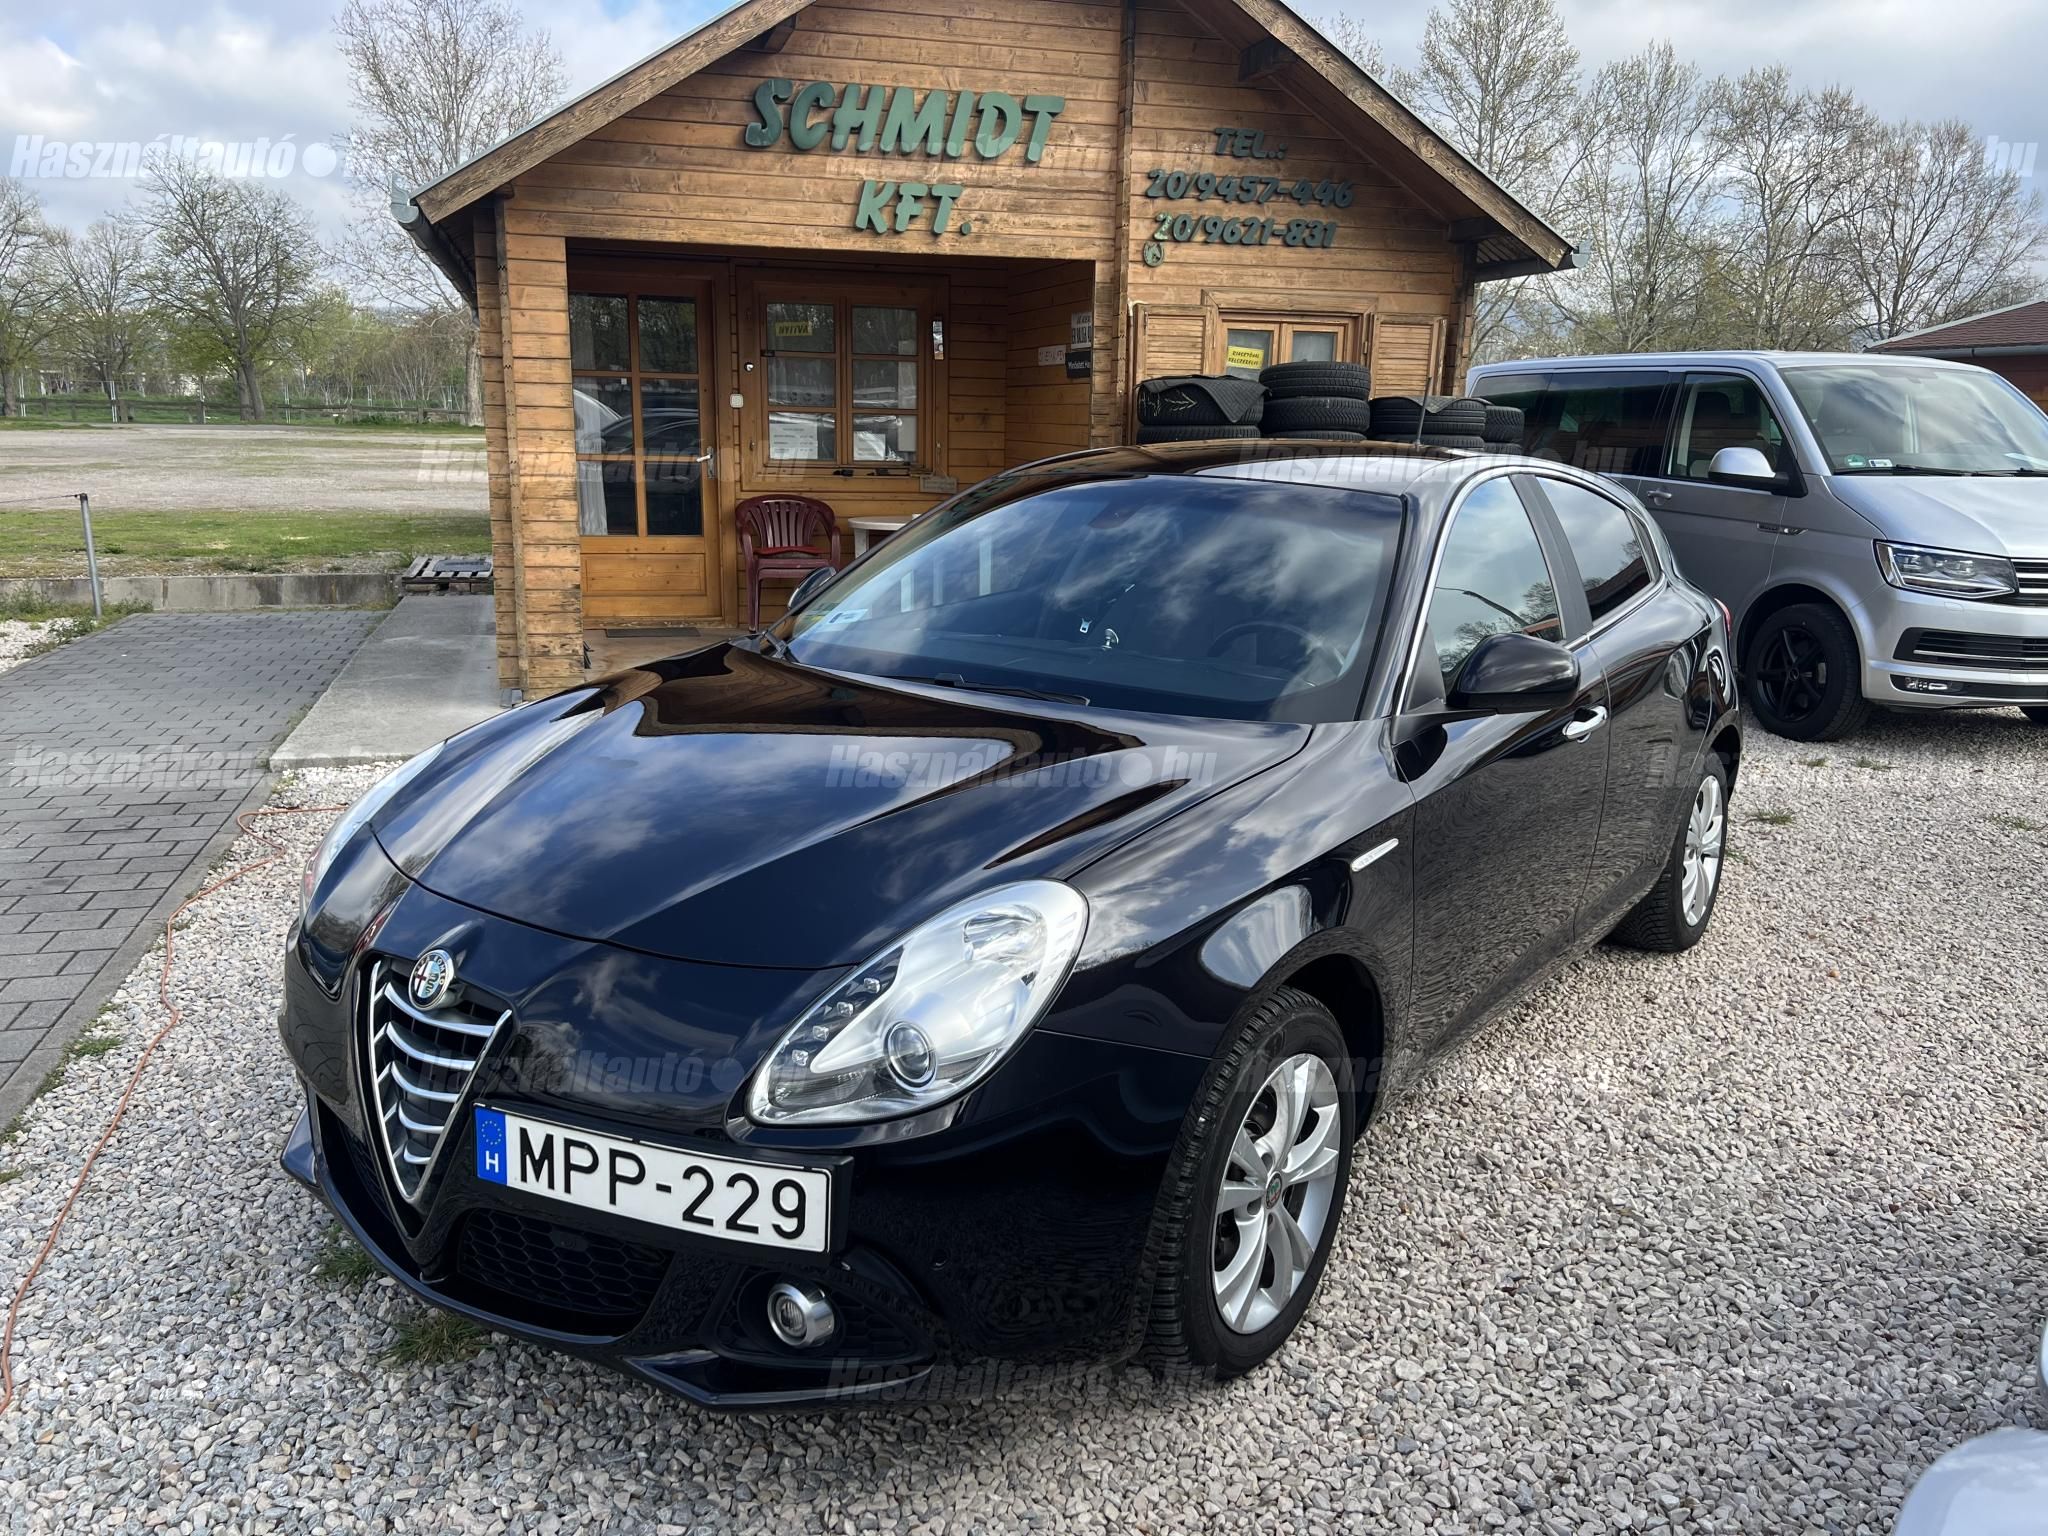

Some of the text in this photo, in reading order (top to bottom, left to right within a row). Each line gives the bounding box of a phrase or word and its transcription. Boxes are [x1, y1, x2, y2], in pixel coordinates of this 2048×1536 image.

[745, 79, 1065, 162] SCHMIDT
[1215, 127, 1287, 159] TEL.:
[855, 179, 972, 234] KFT.
[1146, 168, 1354, 208] 20/9457-446
[1153, 211, 1338, 248] 20/9621-831
[485, 1150, 499, 1173] H
[519, 1126, 807, 1240] MPP-229
